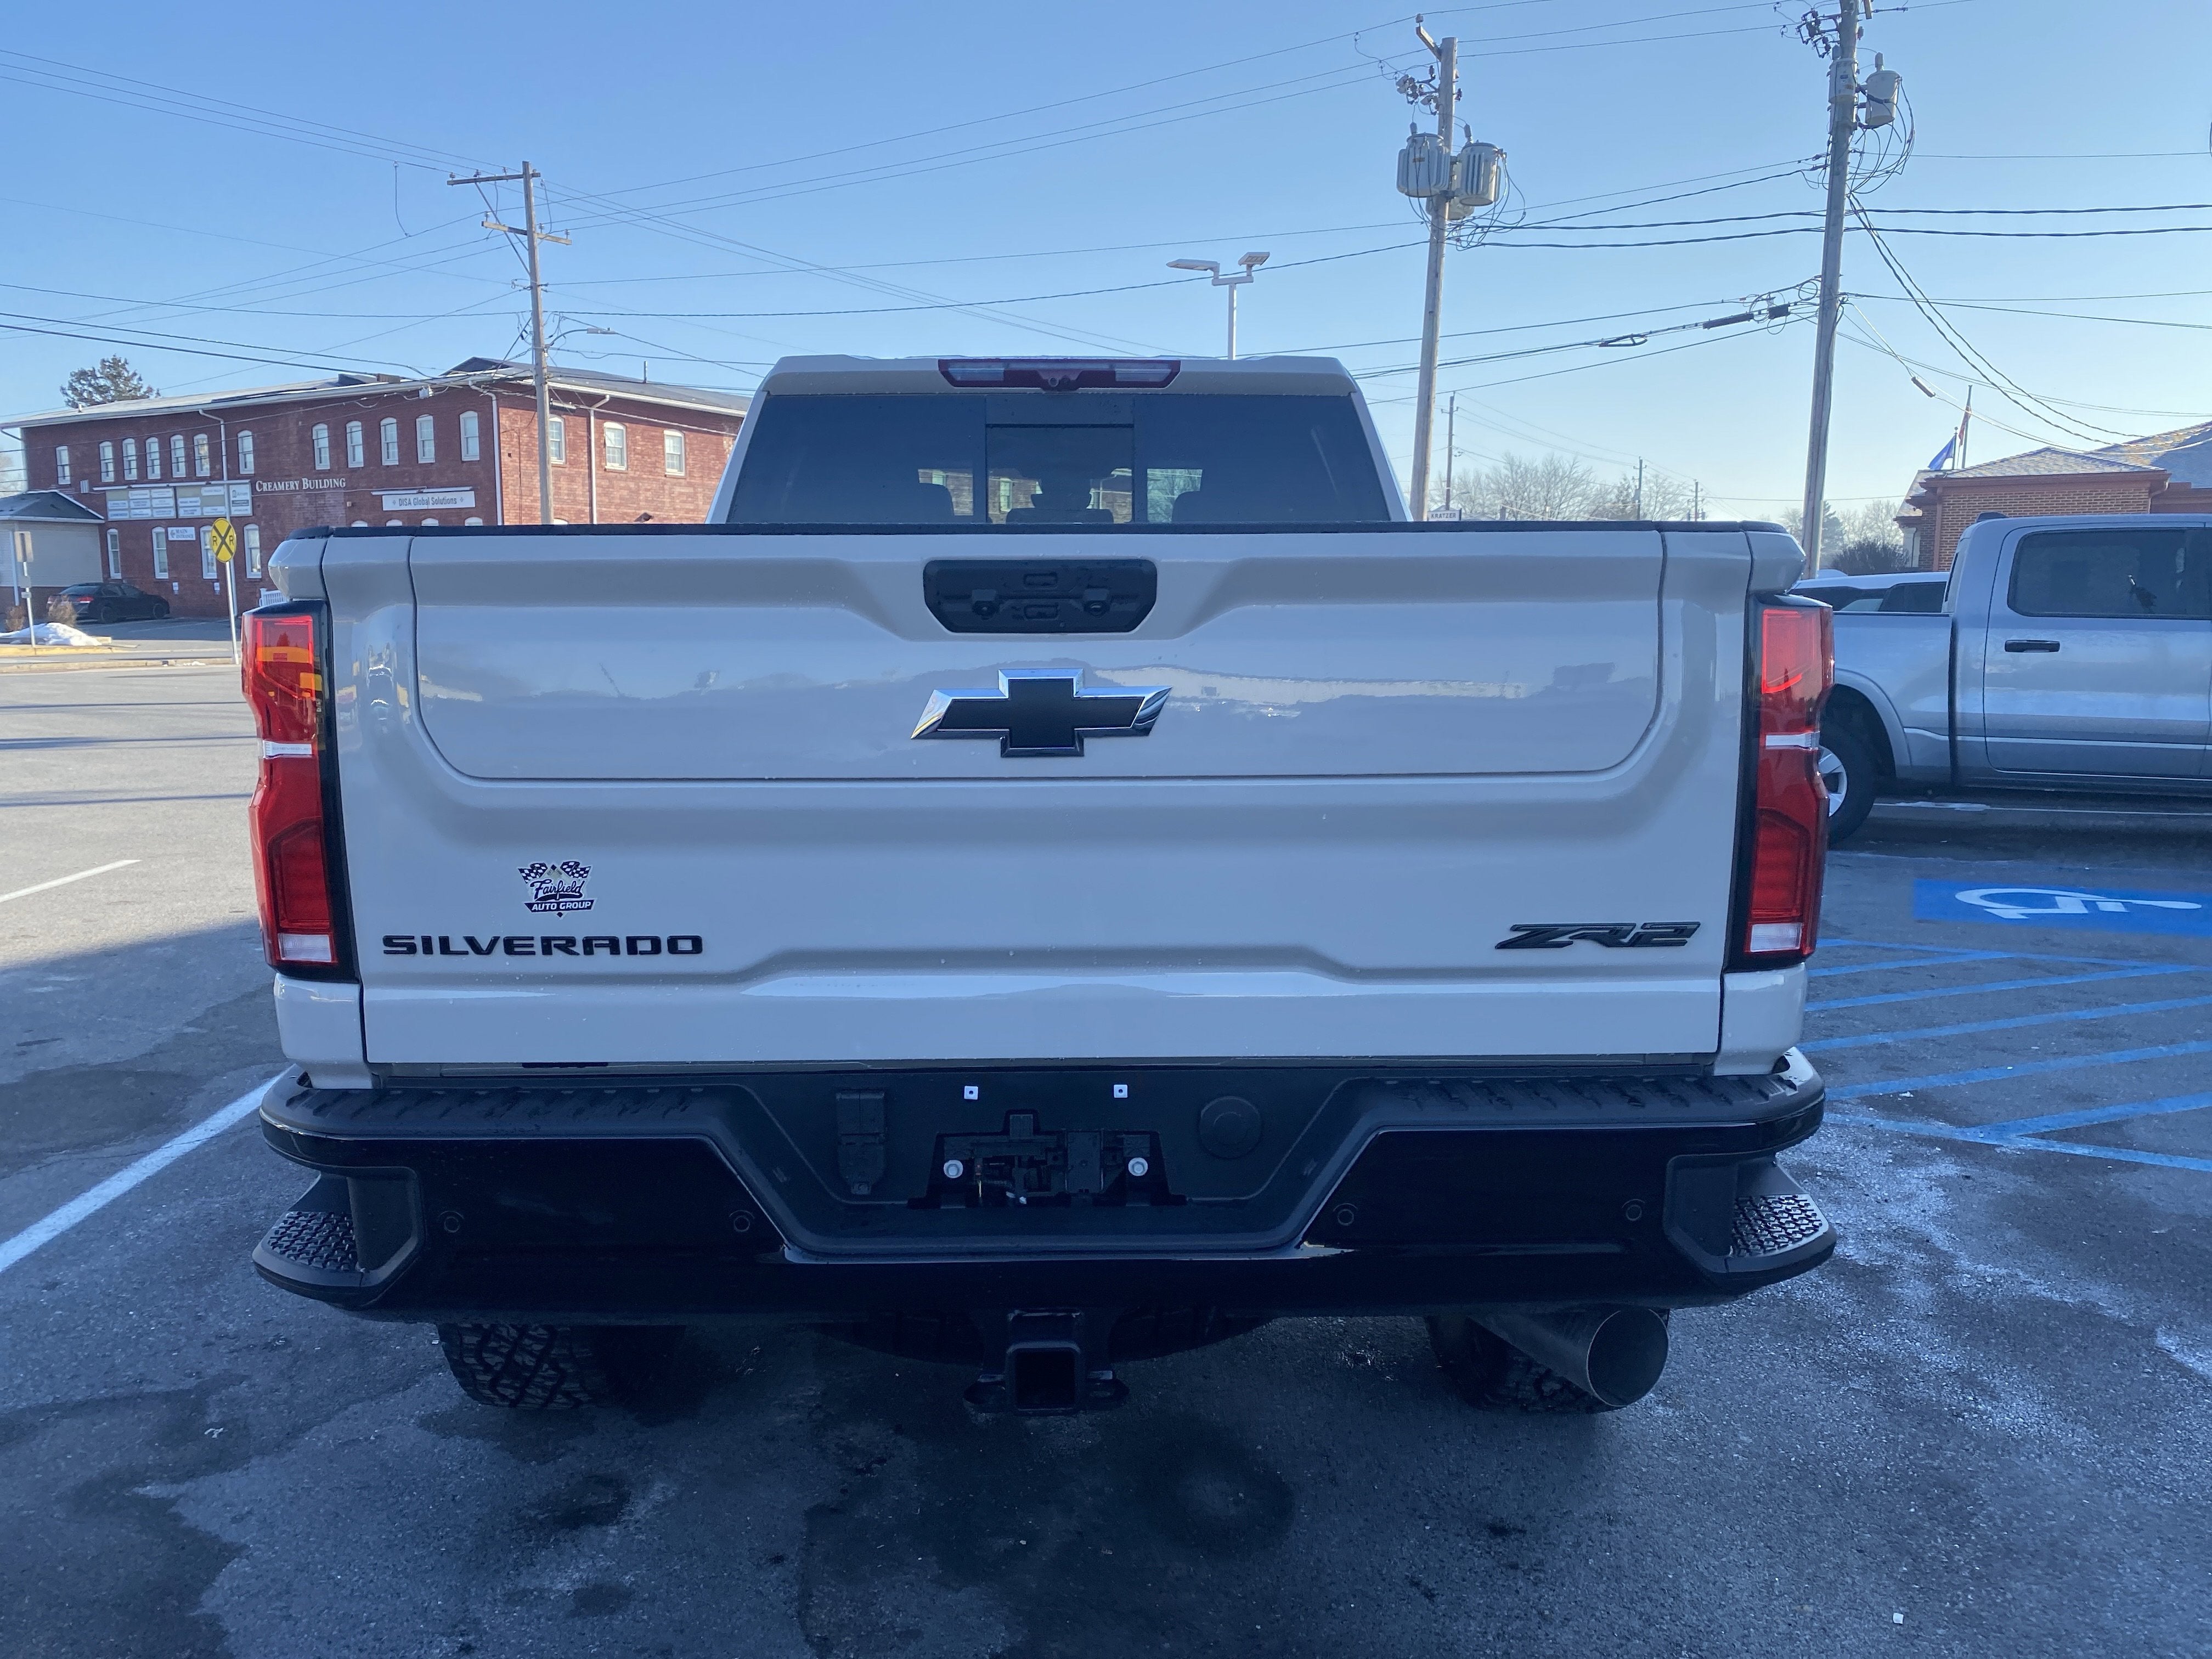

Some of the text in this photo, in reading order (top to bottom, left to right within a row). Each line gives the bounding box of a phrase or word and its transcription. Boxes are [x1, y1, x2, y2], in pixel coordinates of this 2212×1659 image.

[256, 478, 346, 492] CREAMERY BUILDING
[398, 496, 457, 506] DISA Global Solutions
[212, 535, 234, 546] R R
[530, 879, 585, 900] Fairfield
[560, 901, 591, 910] GROUP
[1495, 921, 1701, 950] ZR2
[382, 935, 703, 956] SILVERADO
